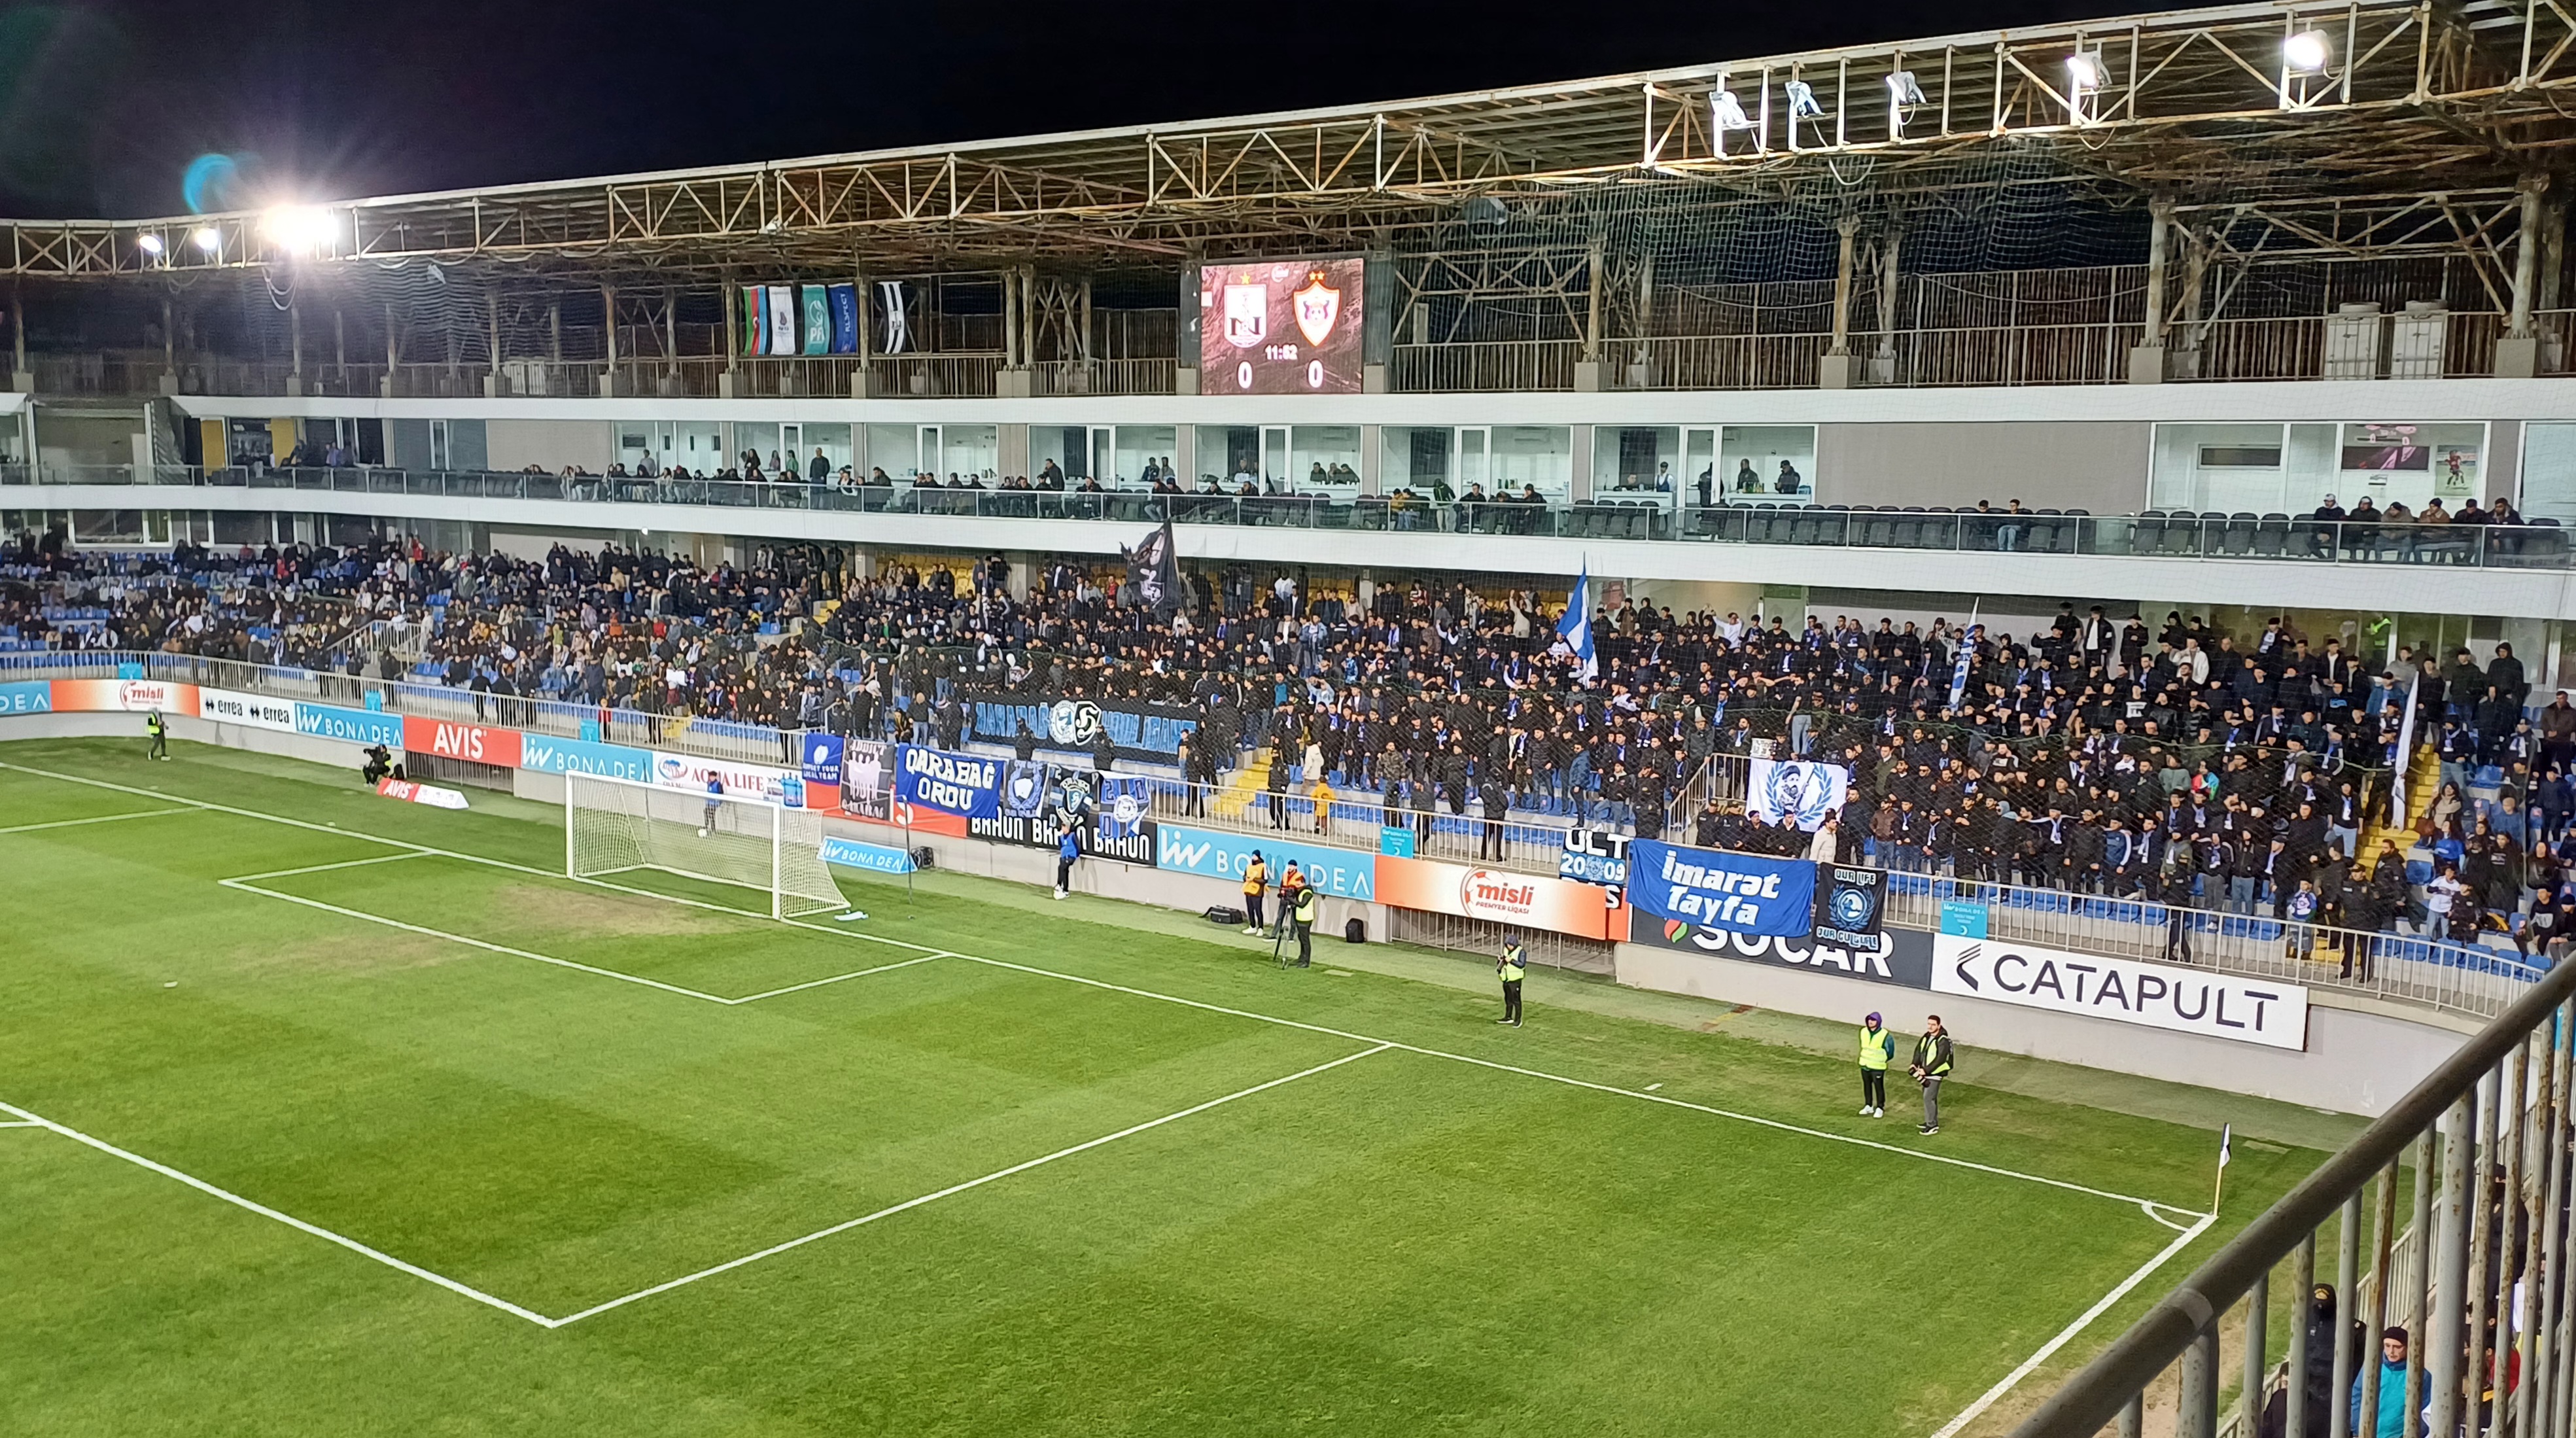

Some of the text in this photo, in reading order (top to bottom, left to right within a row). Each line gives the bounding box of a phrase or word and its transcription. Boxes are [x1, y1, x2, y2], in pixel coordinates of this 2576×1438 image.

[1237, 360, 1323, 389] 0 0
[325, 718, 367, 741] BONA
[372, 724, 403, 746] DEA
[433, 723, 483, 760] AVIS
[557, 752, 606, 775] BONA
[614, 761, 650, 782] DEA
[733, 772, 764, 791] LIFE
[905, 748, 995, 790] QARABAĞ
[383, 779, 412, 799] AVIS
[917, 777, 973, 810] ORDU
[971, 805, 1024, 841] BRAUN
[1093, 827, 1150, 860] BRAUN
[1565, 828, 1635, 859] ULT
[841, 849, 873, 865] BONA
[876, 855, 900, 869] DEA
[1309, 864, 1370, 896] DEA
[1834, 868, 1876, 886] OUR LIFE
[1475, 902, 1506, 911] PREMYER
[1476, 883, 1535, 905] misli
[1667, 885, 1760, 926] Tayfa
[1817, 926, 1837, 941] OUR
[1993, 953, 2279, 1032] CATAPULT
